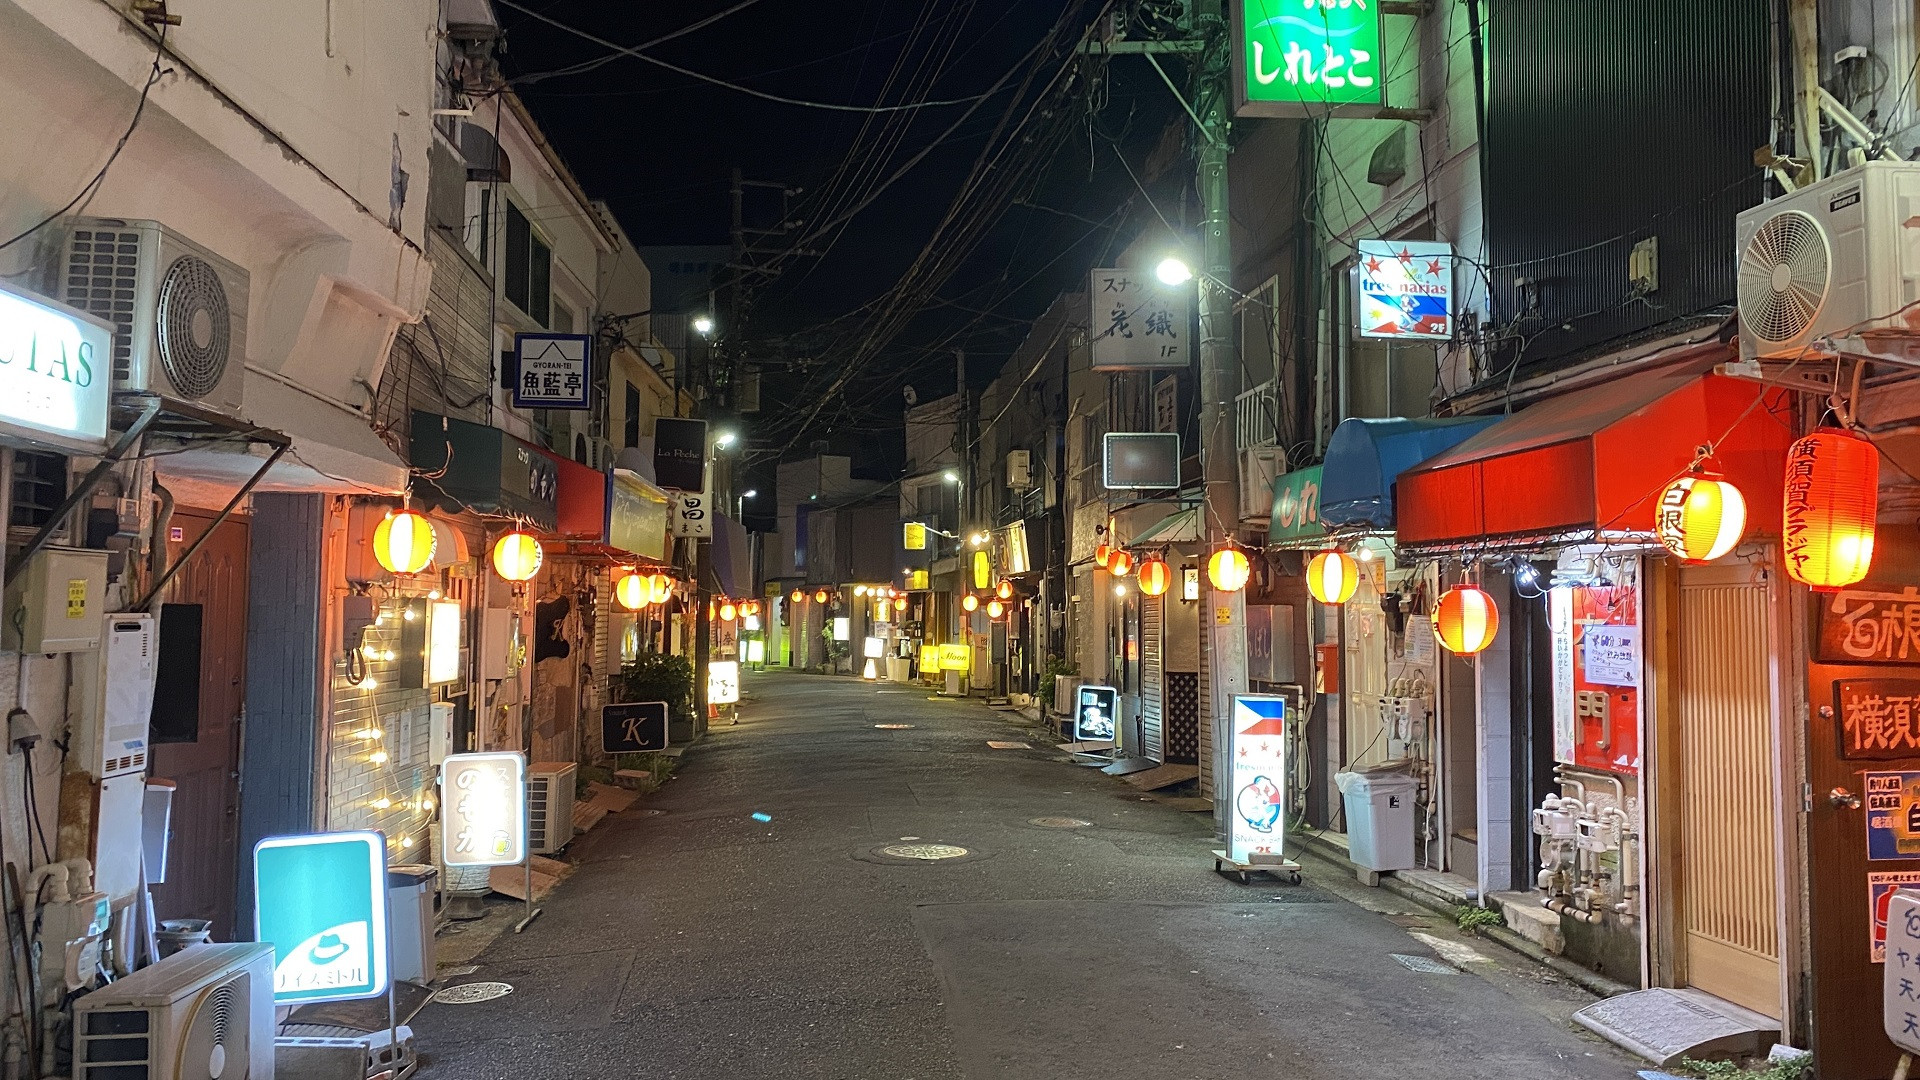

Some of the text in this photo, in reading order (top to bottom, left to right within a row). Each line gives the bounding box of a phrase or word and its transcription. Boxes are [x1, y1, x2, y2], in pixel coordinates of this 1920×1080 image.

[1252, 41, 1374, 88] しれとこ
[1109, 309, 1177, 339] 花織
[1430, 323, 1445, 333] 2F
[1161, 345, 1177, 357] 1F
[522, 371, 581, 396] 魚藍亭
[681, 498, 704, 520] 昌
[682, 524, 703, 533] まさ
[622, 717, 649, 746] K
[1845, 695, 1920, 749] 横須
